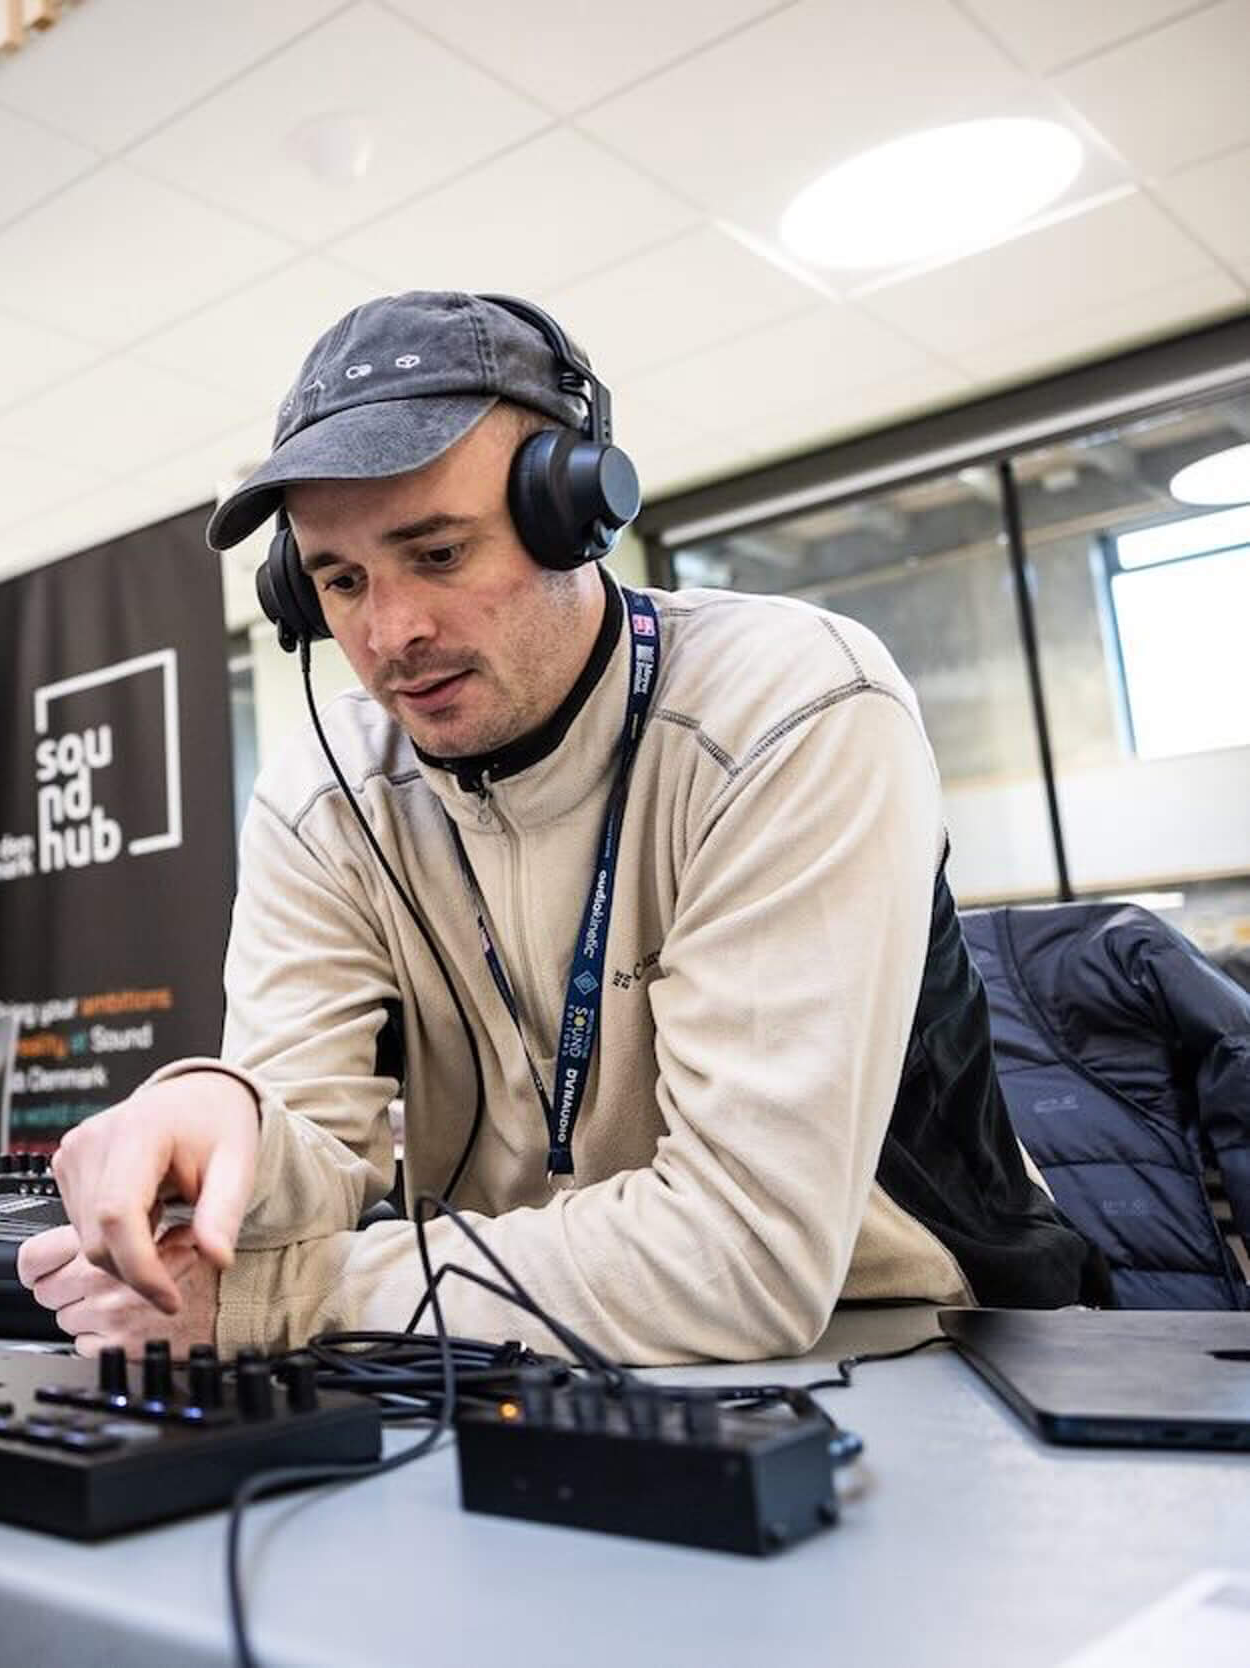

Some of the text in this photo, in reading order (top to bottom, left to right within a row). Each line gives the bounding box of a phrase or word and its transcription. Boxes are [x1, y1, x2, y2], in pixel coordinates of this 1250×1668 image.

[36, 724, 112, 782] sou
[38, 765, 91, 823] nd
[39, 806, 122, 873] hub
[90, 1021, 153, 1053] Sound
[569, 1006, 588, 1059] SOUND
[26, 1064, 108, 1093] Denmark
[557, 1067, 578, 1144] DYNAUDIO
